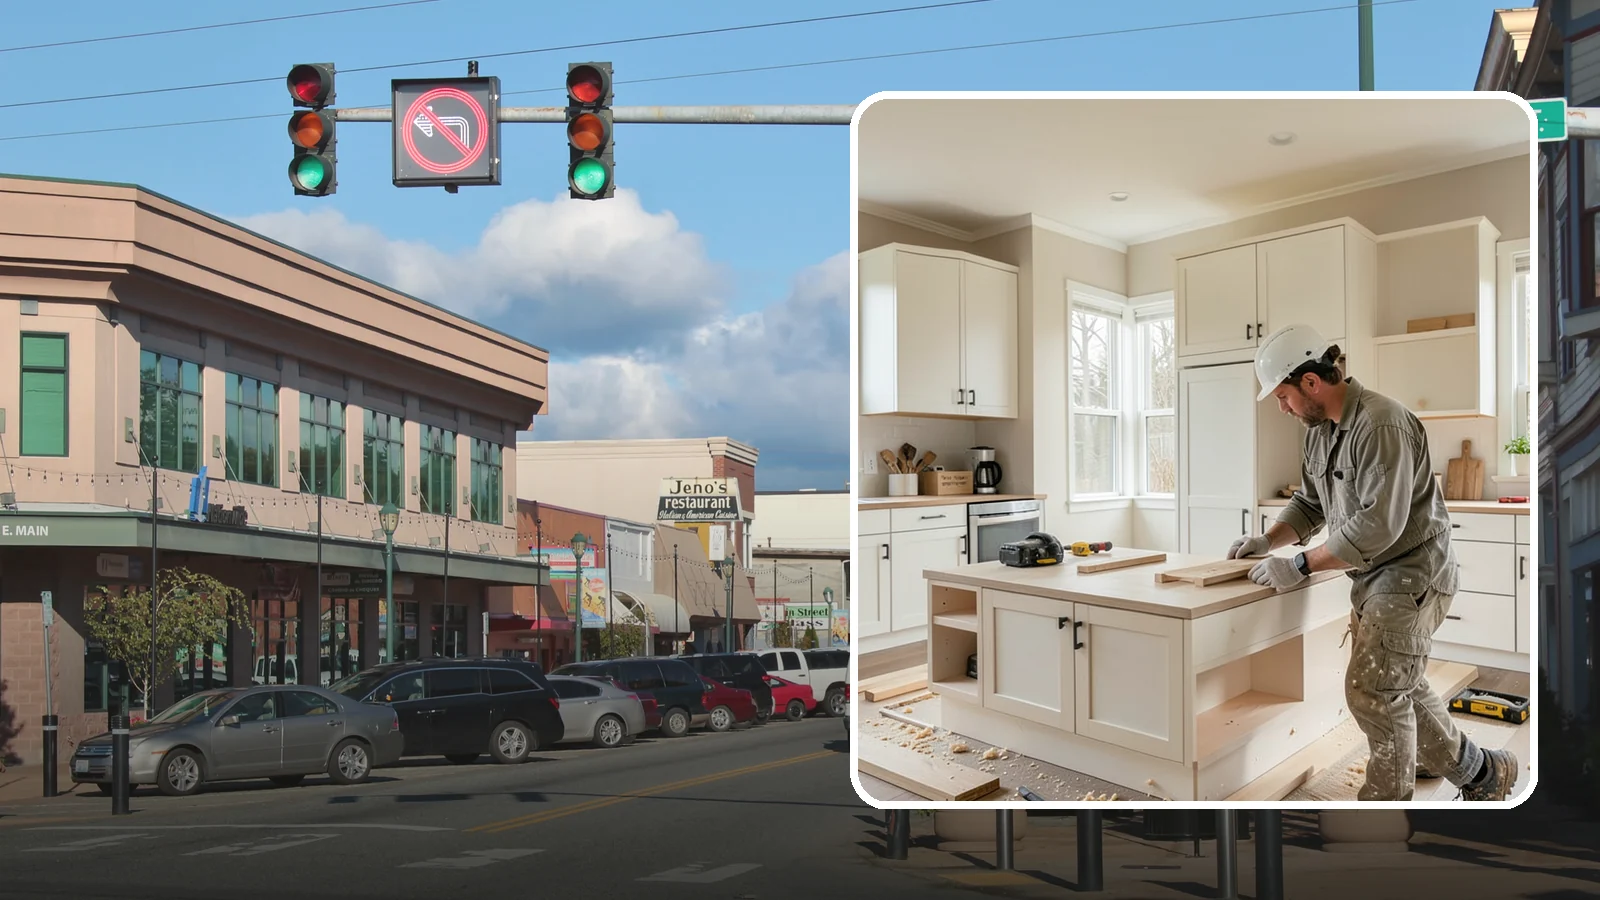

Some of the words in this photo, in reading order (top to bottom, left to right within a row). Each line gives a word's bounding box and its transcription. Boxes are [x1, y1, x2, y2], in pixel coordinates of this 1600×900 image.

[670, 480, 727, 494] Jeno's
[665, 496, 730, 509] restaurant
[659, 510, 681, 520] Italian
[686, 510, 714, 519] American
[715, 510, 737, 519] Cuisine
[2, 525, 13, 536] E.
[15, 525, 49, 536] MAIN
[797, 607, 828, 616] Street
